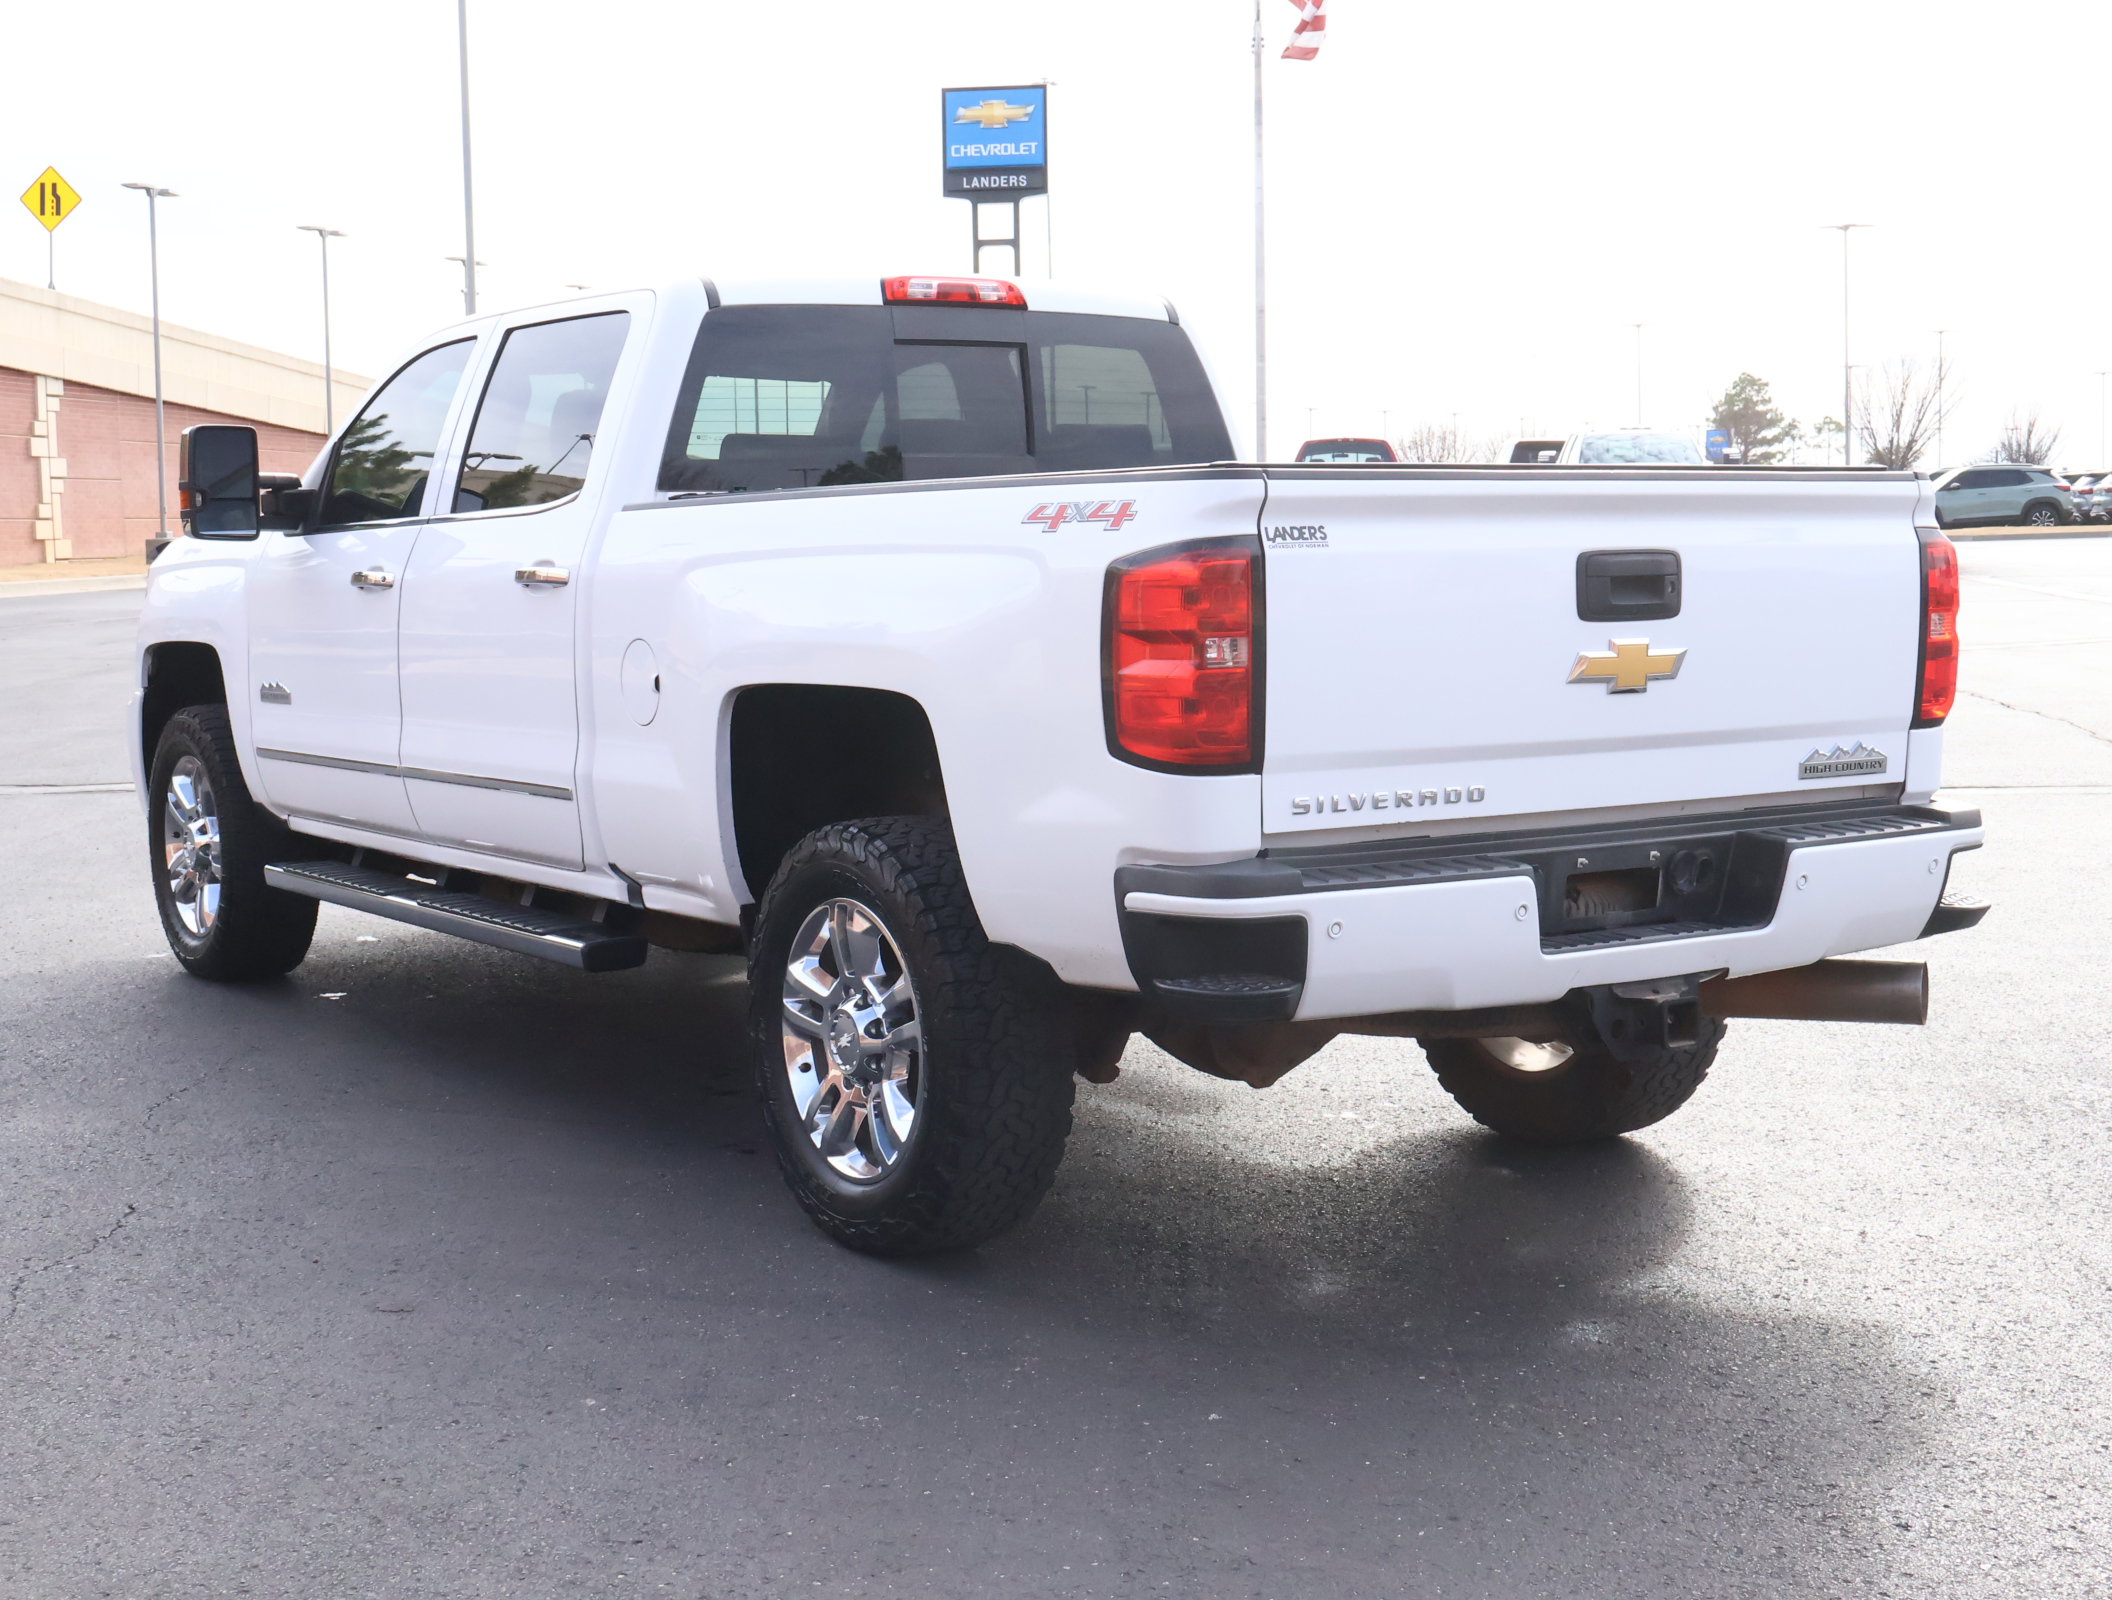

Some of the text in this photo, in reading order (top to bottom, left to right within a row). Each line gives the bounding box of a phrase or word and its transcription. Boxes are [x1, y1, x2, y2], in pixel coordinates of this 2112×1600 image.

[950, 142, 1038, 157] CHEVROLET
[962, 175, 1027, 189] LANDERS
[1264, 525, 1328, 543] LANDERS
[1804, 760, 1884, 774] HIGH COUNTRY
[1292, 784, 1486, 815] SILVERADO
